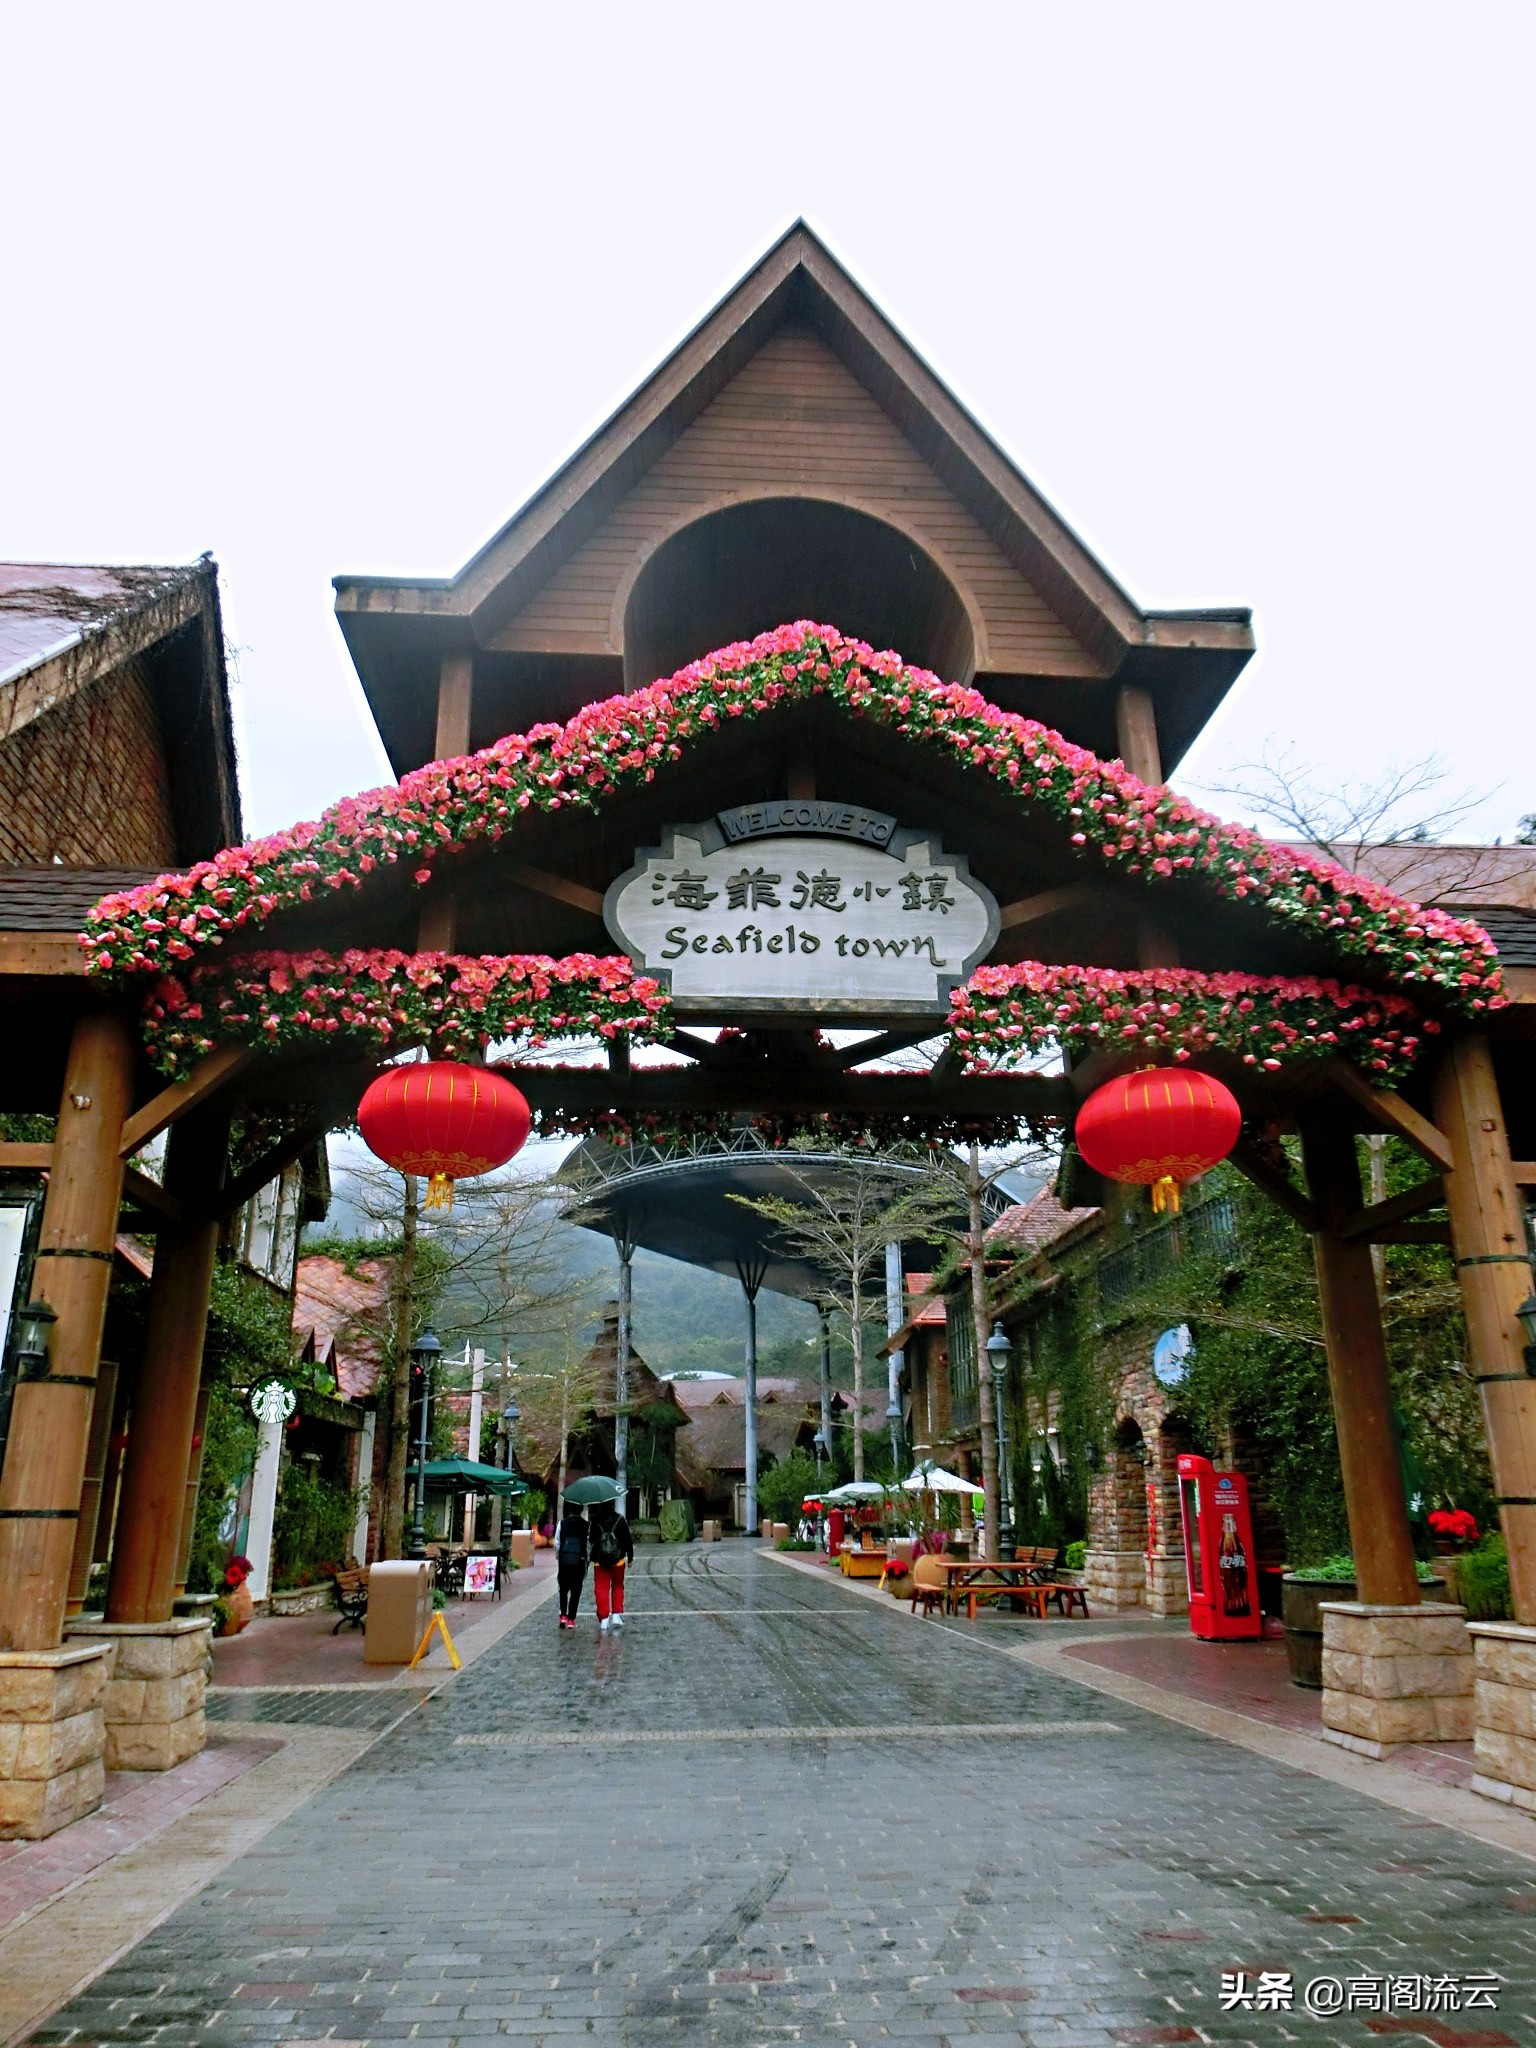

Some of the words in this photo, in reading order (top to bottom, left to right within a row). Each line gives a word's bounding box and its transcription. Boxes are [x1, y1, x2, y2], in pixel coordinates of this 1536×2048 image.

[722, 808, 854, 838] WELCOME
[860, 818, 889, 841] TO
[661, 924, 821, 959] Seafield
[834, 934, 947, 967] town
